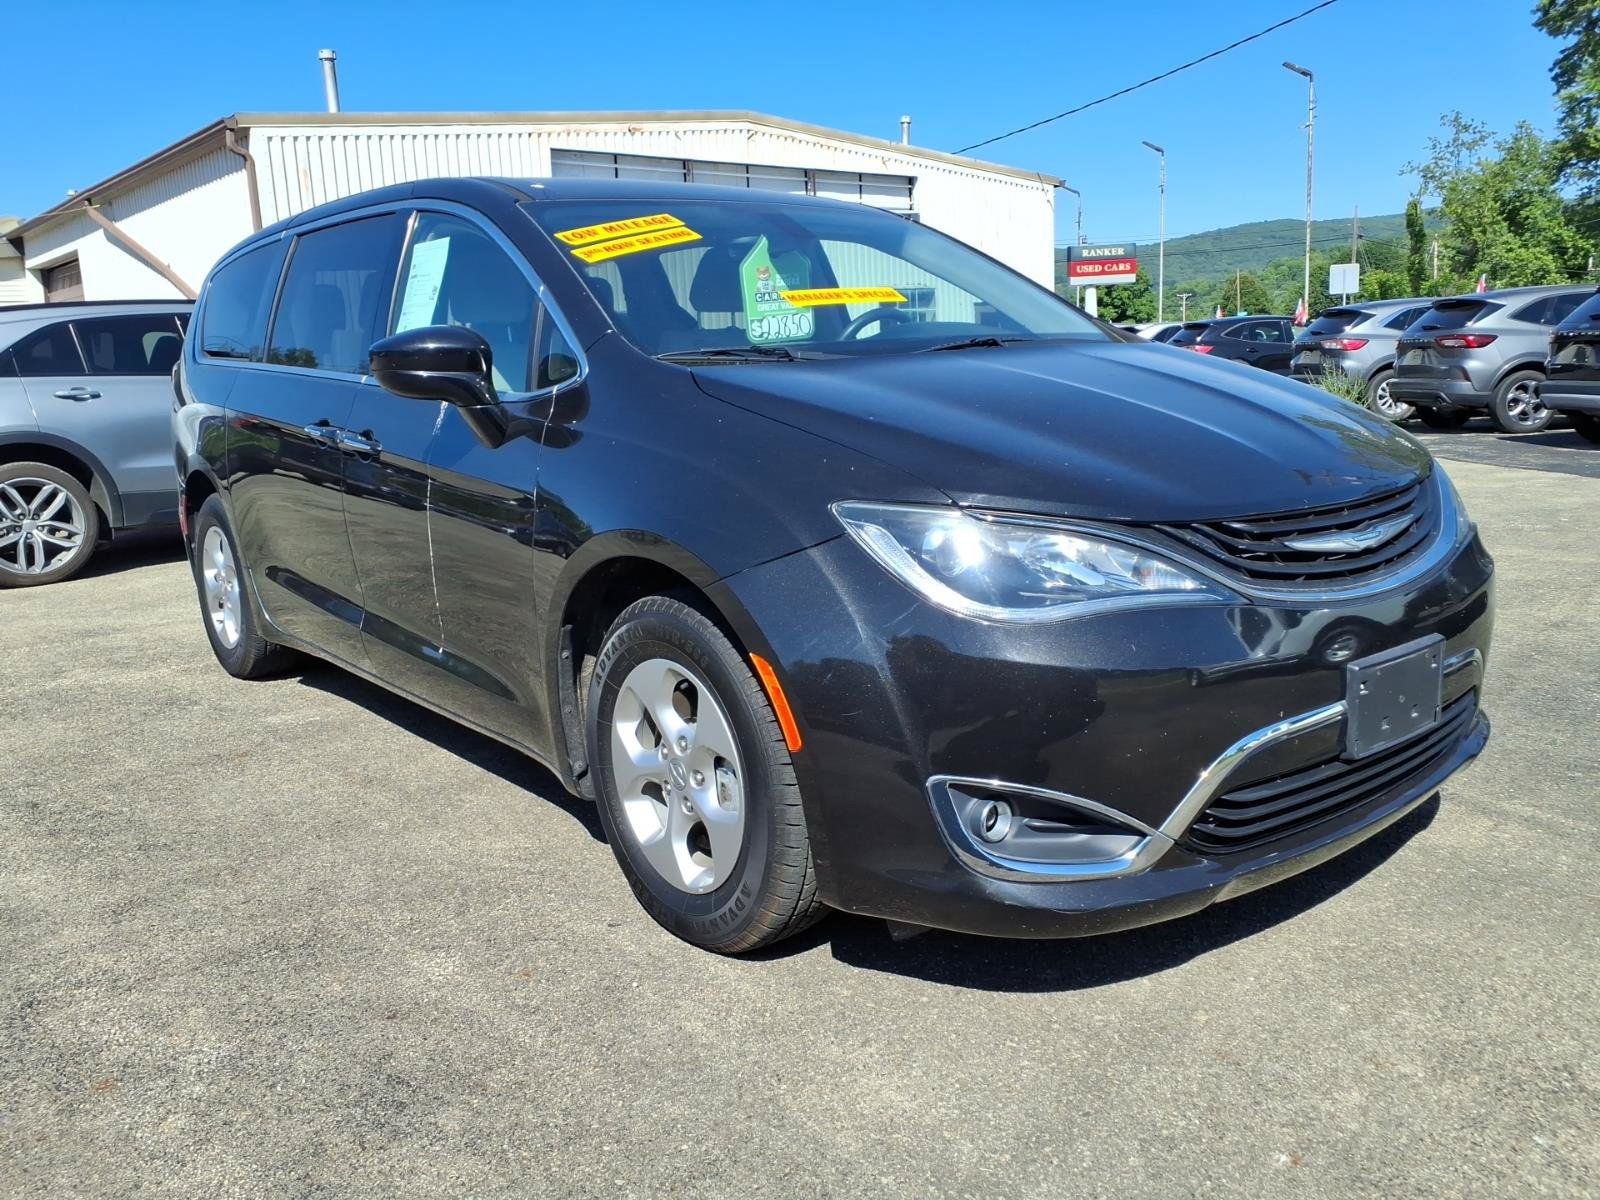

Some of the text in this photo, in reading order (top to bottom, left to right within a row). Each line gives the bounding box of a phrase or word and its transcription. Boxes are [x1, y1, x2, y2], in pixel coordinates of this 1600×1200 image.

[562, 215, 674, 242] LOW MILEAGE
[602, 242, 634, 253] ROW
[636, 230, 694, 246] SEATING
[1082, 247, 1125, 257] RANKER
[1076, 262, 1131, 273] USED CARS
[785, 290, 900, 301] MANAGER'S SPECIAL
[757, 302, 779, 312] GREAT
